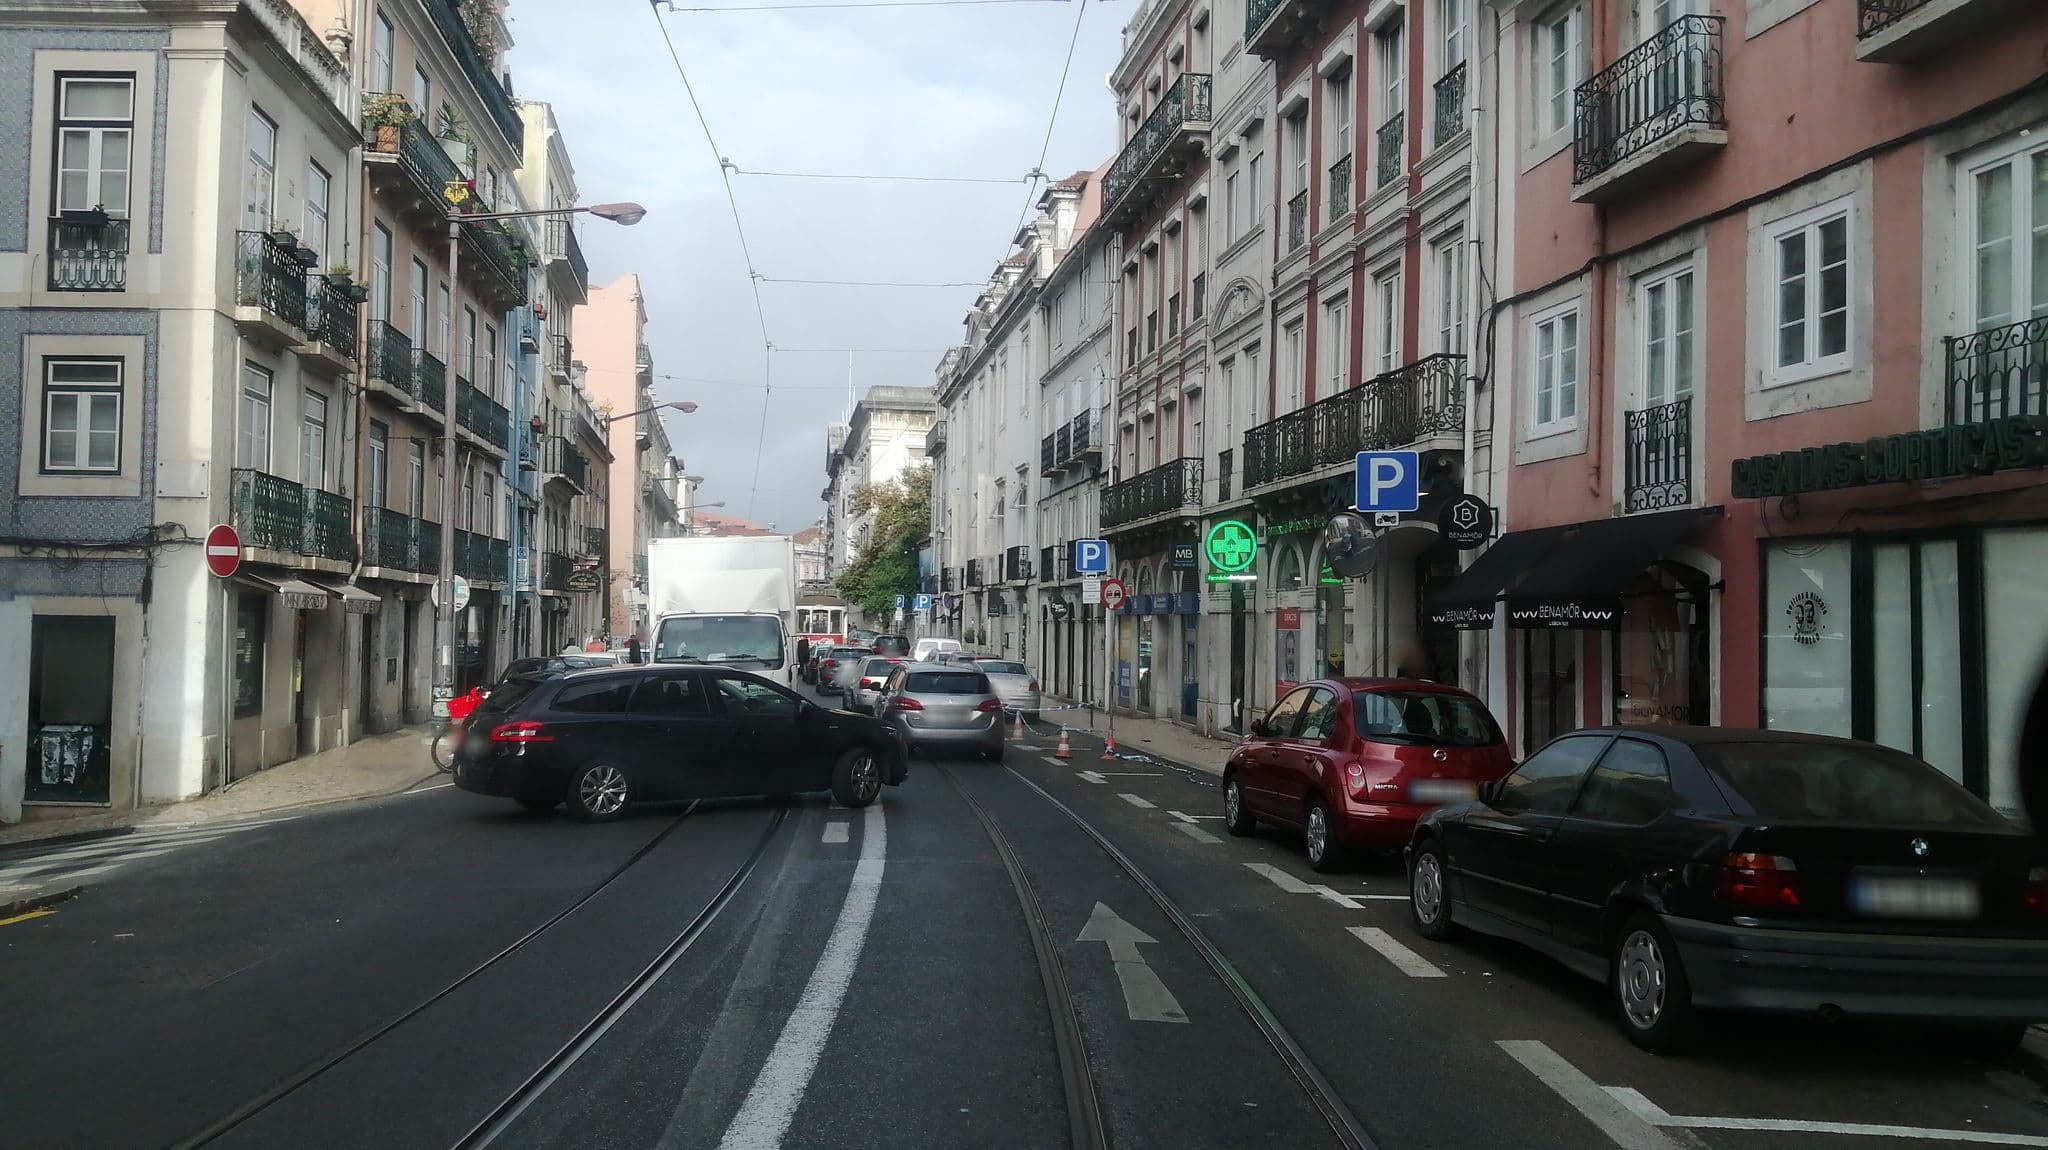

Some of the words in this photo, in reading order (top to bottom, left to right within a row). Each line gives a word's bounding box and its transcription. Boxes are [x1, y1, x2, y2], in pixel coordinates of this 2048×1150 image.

[1734, 457, 1787, 497] CASA
[1800, 444, 1856, 489] DAS
[1370, 457, 1405, 506] P
[1461, 508, 1473, 521] B
[1083, 543, 1101, 569] P
[1175, 549, 1193, 559] MB
[919, 595, 929, 608] P
[1447, 608, 1478, 622] BENAMÔR
[1539, 603, 1580, 618] BENAMÔR
